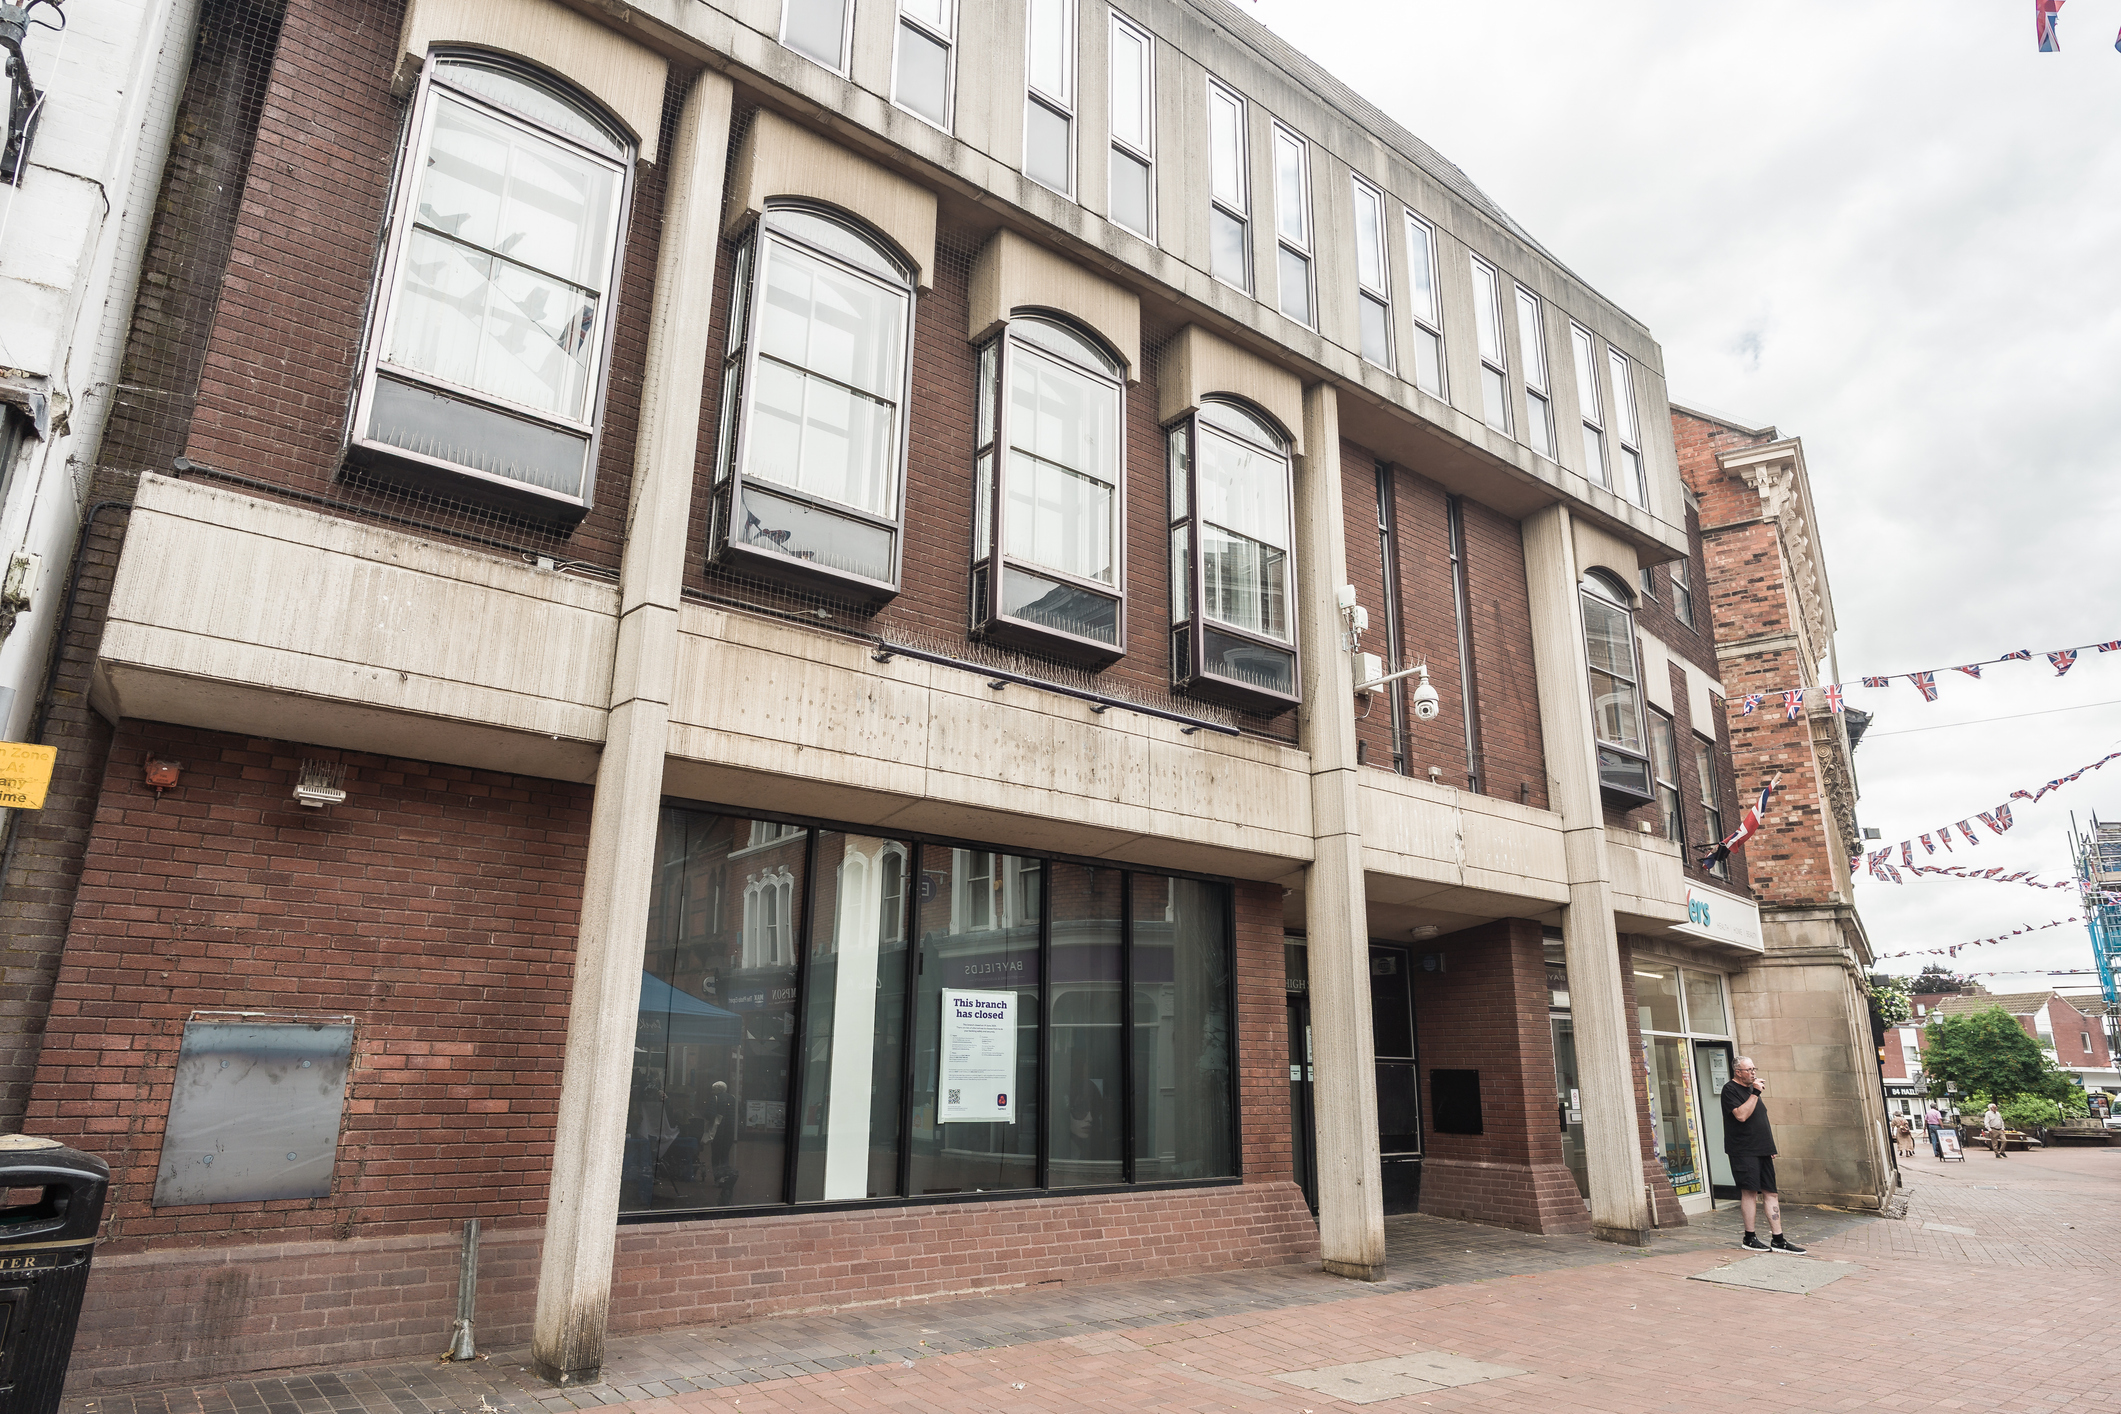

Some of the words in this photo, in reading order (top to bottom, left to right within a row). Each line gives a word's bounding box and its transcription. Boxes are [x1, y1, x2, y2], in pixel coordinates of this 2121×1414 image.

[11, 747, 49, 761] Zone
[953, 998, 973, 1008] This
[975, 999, 1008, 1010] branch
[956, 1009, 973, 1018] has
[974, 1010, 1004, 1020] closed
[0, 1256, 36, 1269] TER
